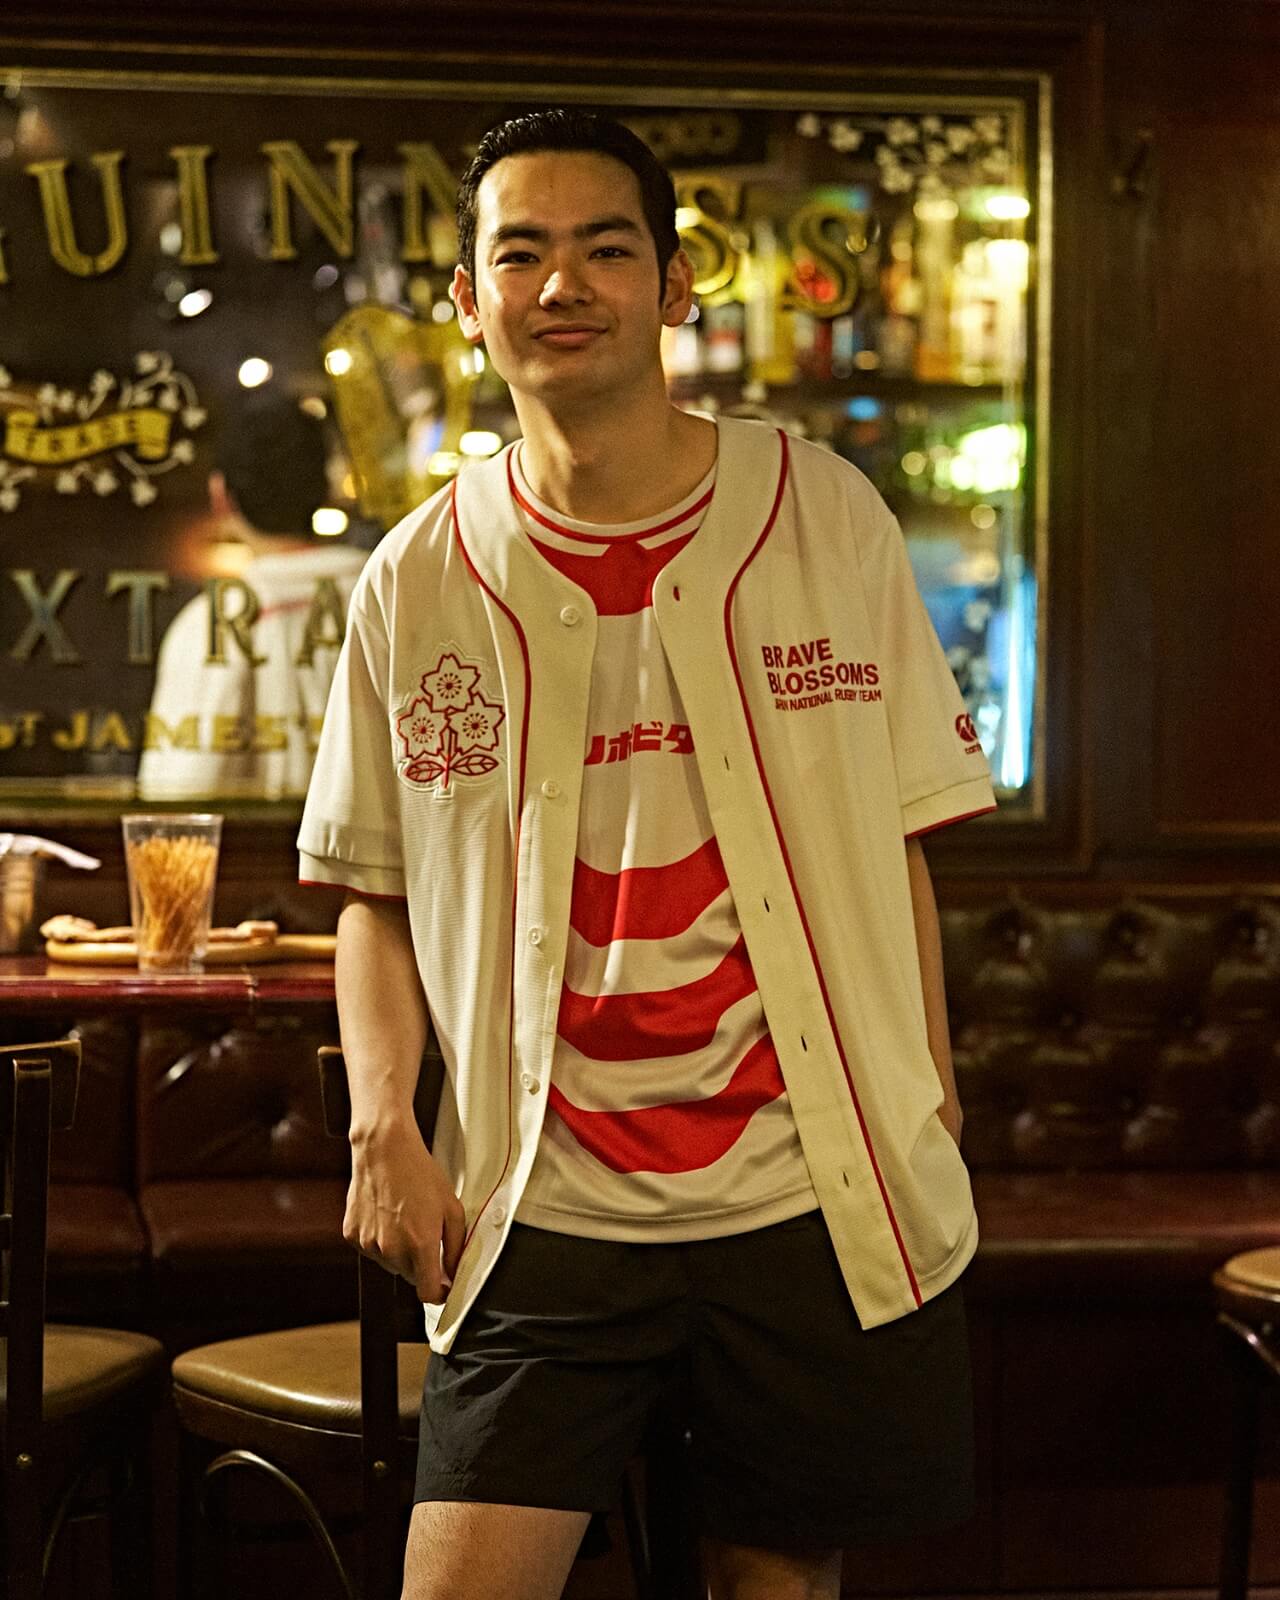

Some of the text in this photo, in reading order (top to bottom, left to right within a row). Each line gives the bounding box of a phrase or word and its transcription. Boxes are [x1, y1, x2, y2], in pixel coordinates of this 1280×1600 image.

[0, 139, 868, 319] UINNSS
[761, 638, 834, 669] BRAVE
[767, 662, 880, 696] BLOSSOMS
[789, 692, 834, 712] NATIONAL
